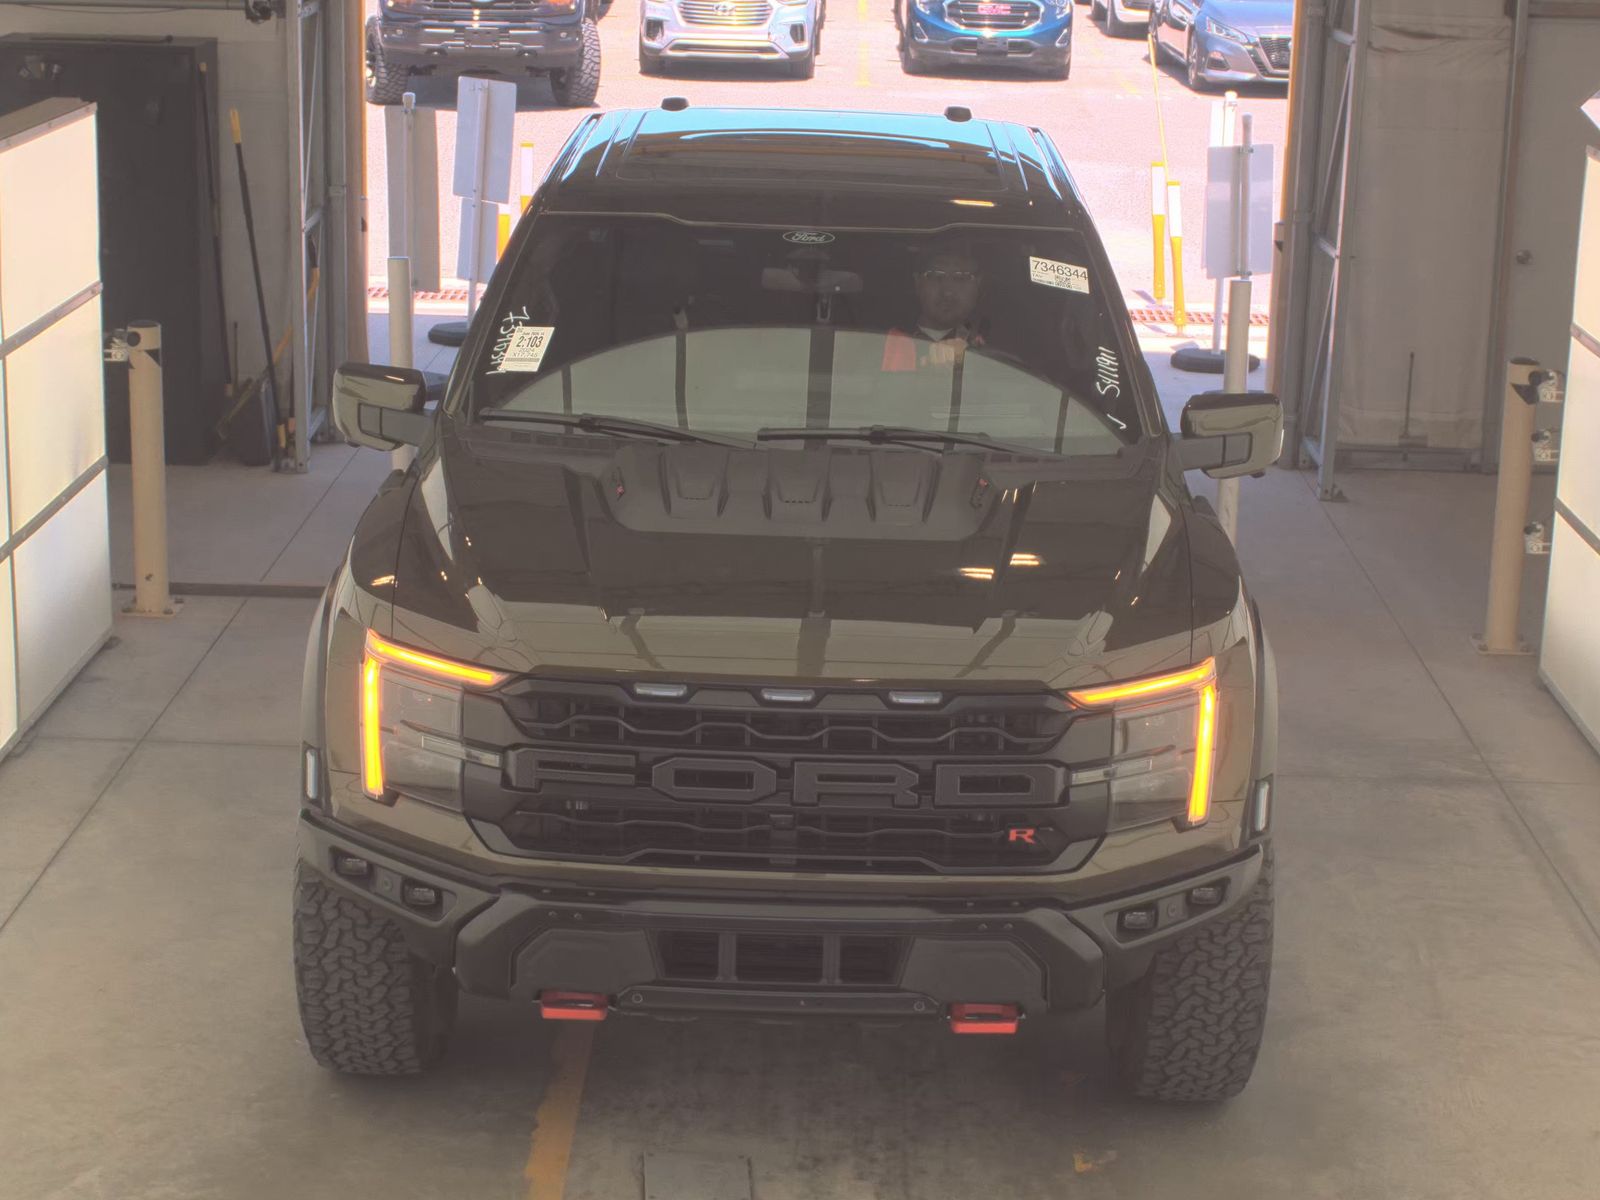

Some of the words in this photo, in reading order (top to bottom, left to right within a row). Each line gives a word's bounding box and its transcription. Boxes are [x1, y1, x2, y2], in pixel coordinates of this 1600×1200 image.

[1032, 259, 1088, 281] 7346344
[515, 335, 544, 348] 2:103
[508, 747, 1064, 808] FORD
[1009, 828, 1037, 845] R
